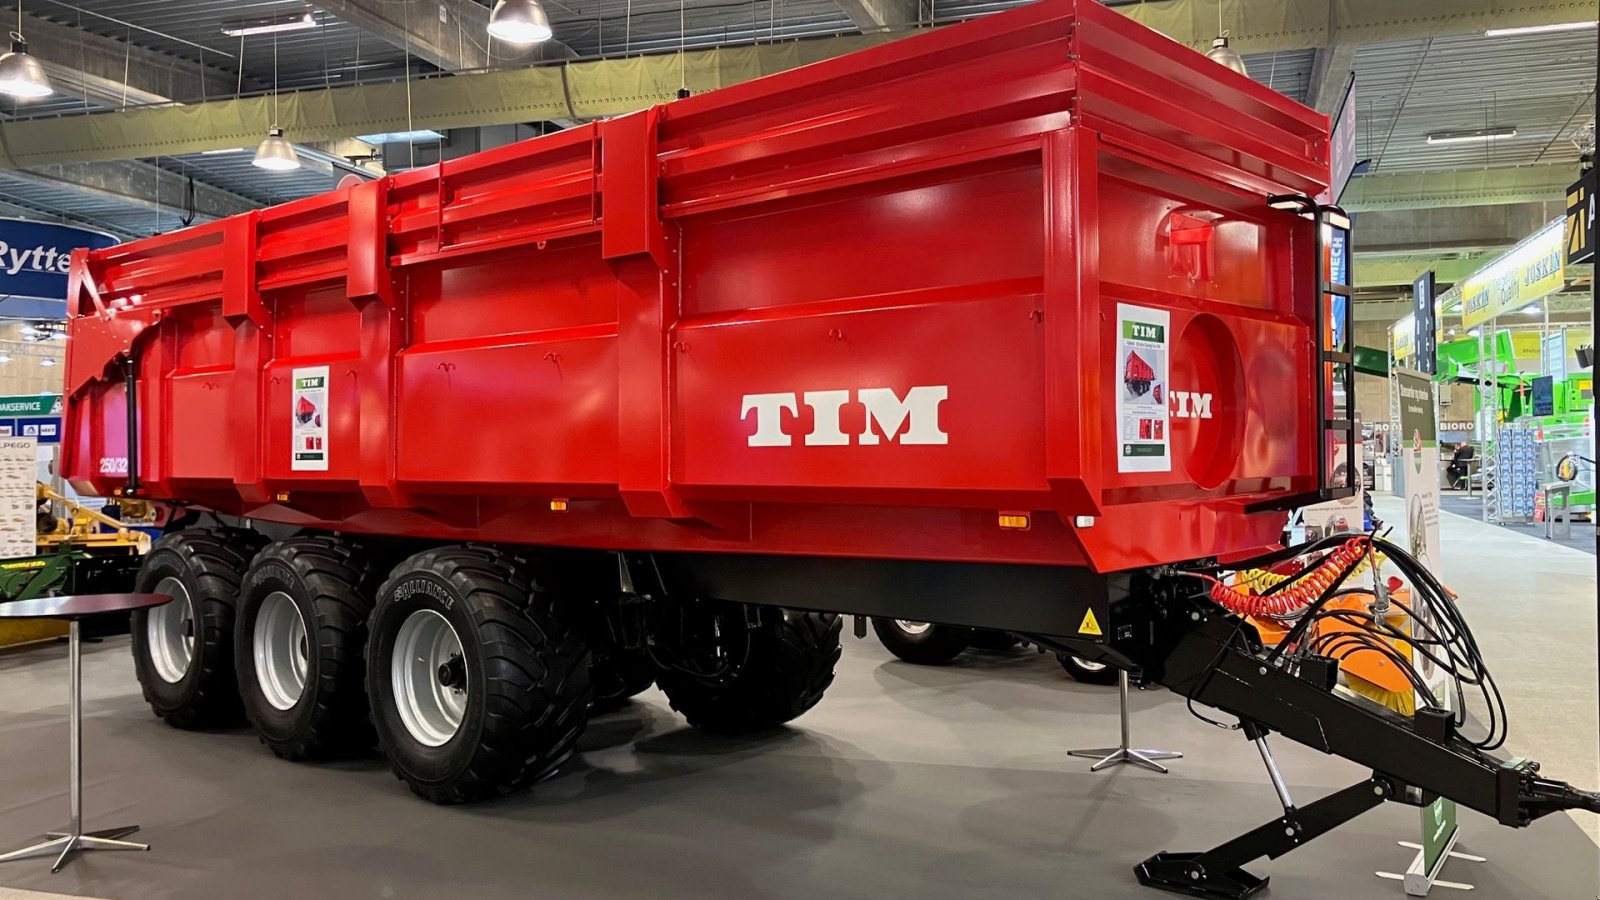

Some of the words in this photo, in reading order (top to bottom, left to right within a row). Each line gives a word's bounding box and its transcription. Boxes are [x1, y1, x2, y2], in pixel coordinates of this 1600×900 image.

[1132, 324, 1156, 338] TIM
[301, 379, 318, 387] TIM
[740, 385, 949, 447] TIM
[100, 457, 128, 472] 250/32
[402, 580, 454, 610] ALLIANCE
